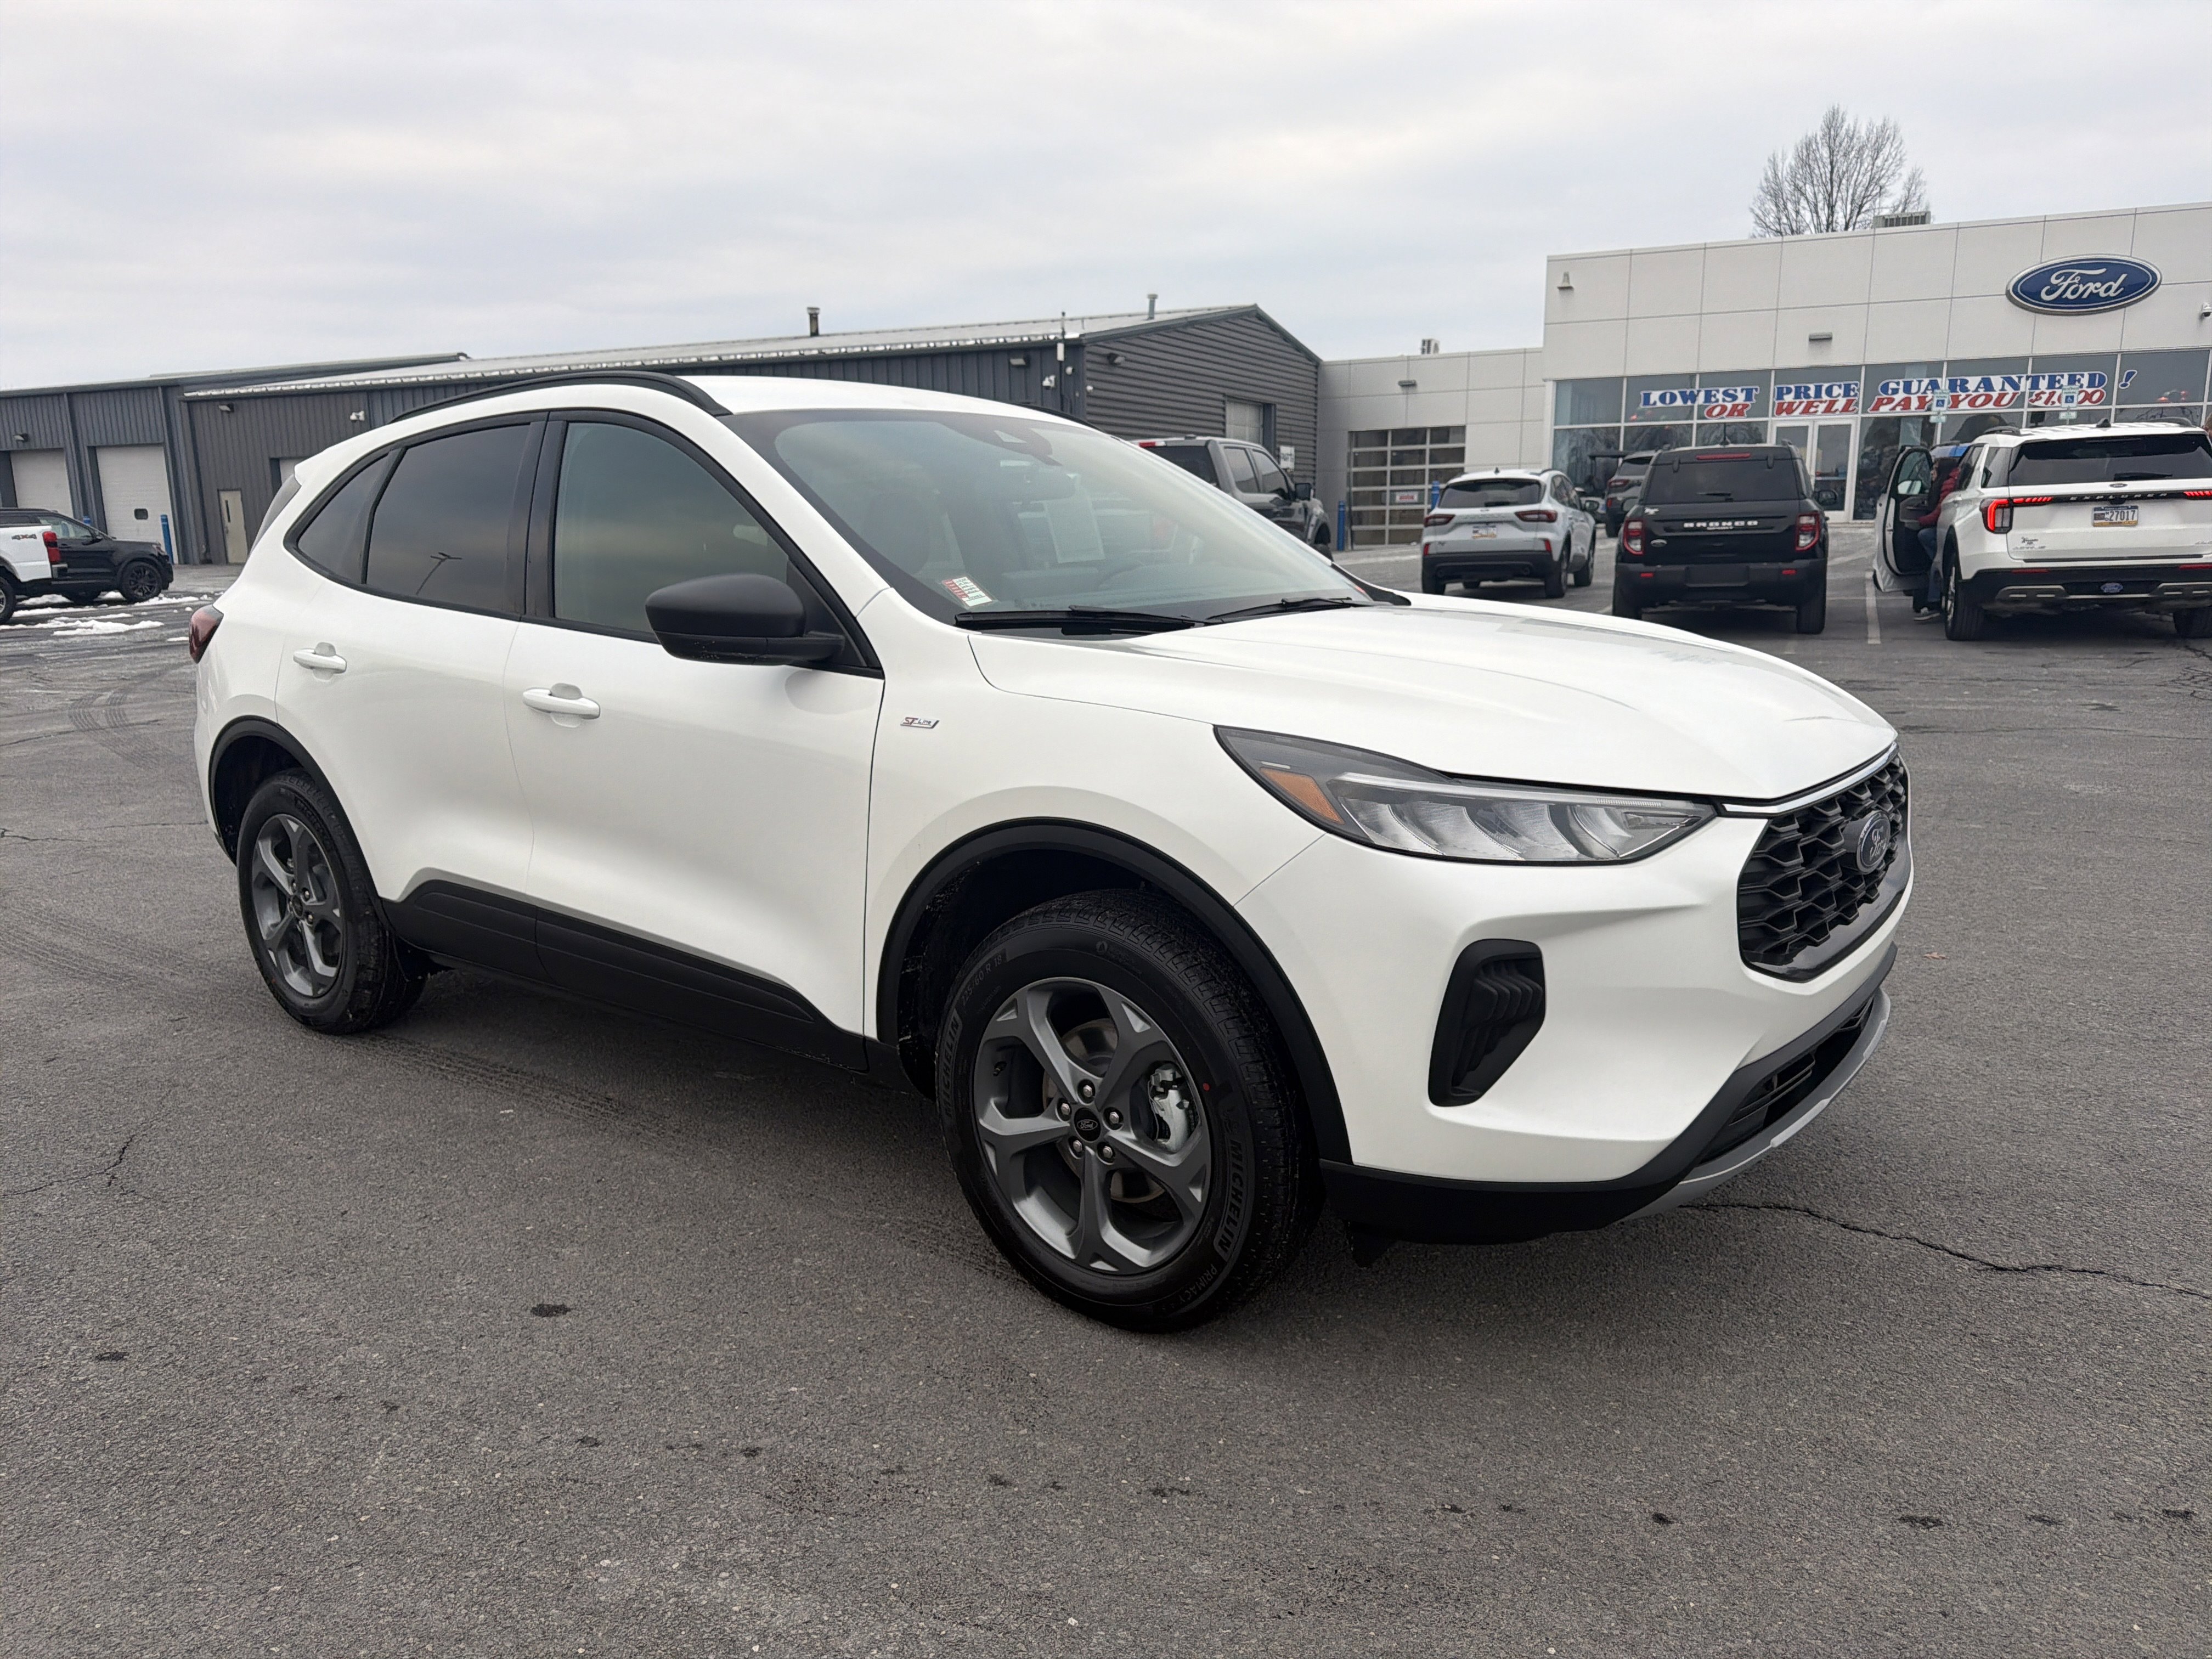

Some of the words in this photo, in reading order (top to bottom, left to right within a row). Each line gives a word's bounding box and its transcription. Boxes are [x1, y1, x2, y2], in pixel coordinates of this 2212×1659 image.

[2040, 268, 2128, 301] Ford
[1642, 387, 1758, 407] LOWEST
[1775, 383, 1859, 401] PRICE
[1880, 373, 2106, 396] GUARANTEED
[2120, 371, 2136, 388] !
[1705, 403, 1749, 417] OR
[1775, 399, 1857, 416] WELL
[1869, 396, 1934, 411] PAY
[1949, 392, 2019, 408] YOU
[2029, 390, 2105, 406] $1,00
[2109, 510, 2136, 522] 27017
[902, 716, 919, 725] ST
[1080, 1120, 1094, 1129] Ford
[1216, 1138, 1244, 1253] MICHELIN
